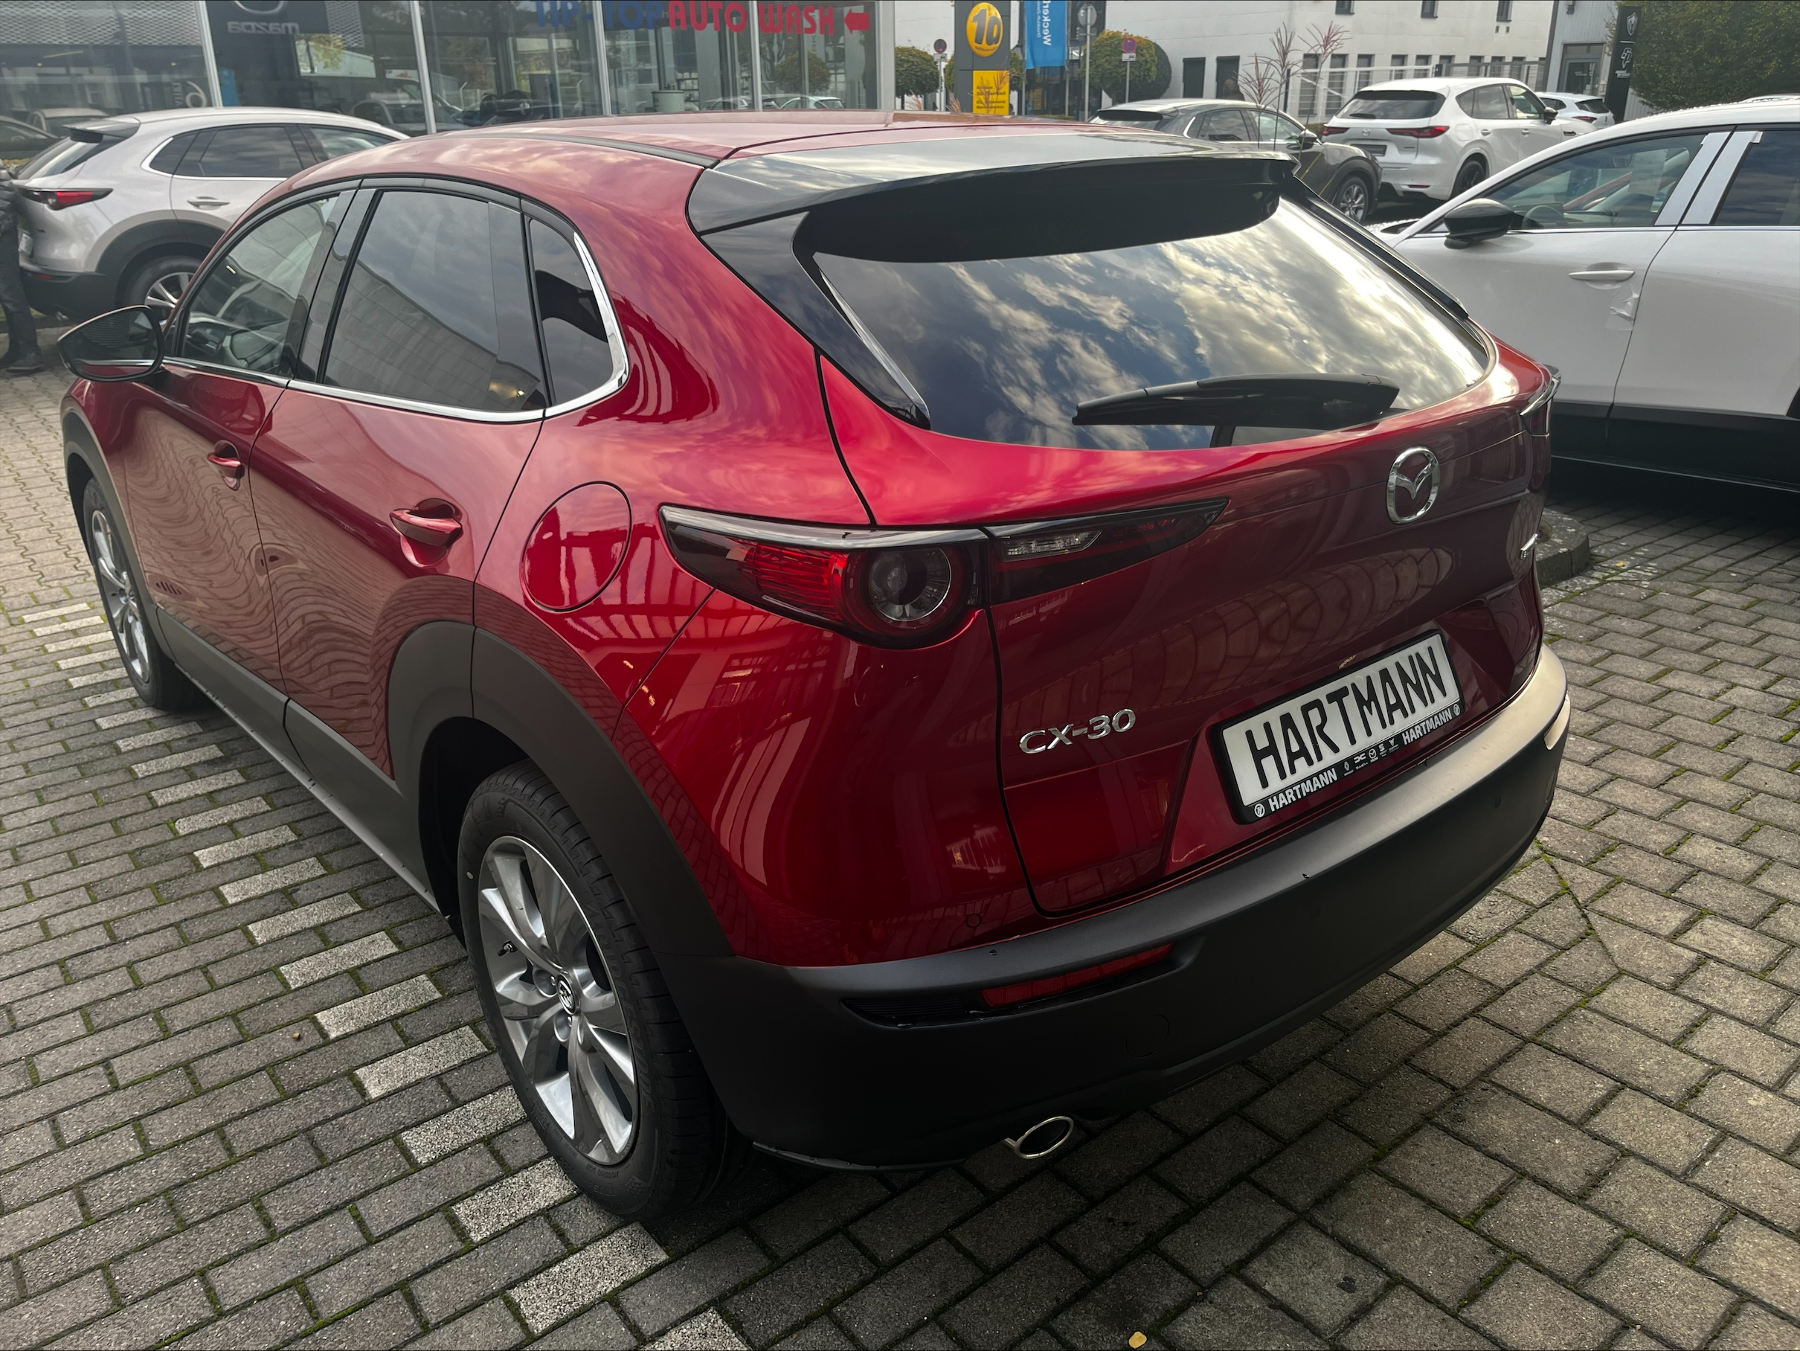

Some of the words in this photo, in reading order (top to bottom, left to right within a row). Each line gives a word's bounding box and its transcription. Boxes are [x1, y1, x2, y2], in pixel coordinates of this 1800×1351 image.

[536, 1, 664, 30] TIP-TOP
[668, 1, 748, 33] AUTO
[759, 3, 835, 35] WASH
[972, 8, 1001, 45] 1a
[1019, 708, 1136, 754] CX-30
[1245, 646, 1447, 789] HARTMANN
[1268, 768, 1338, 812] HARTMANN
[1401, 708, 1453, 745] HARTMANN
